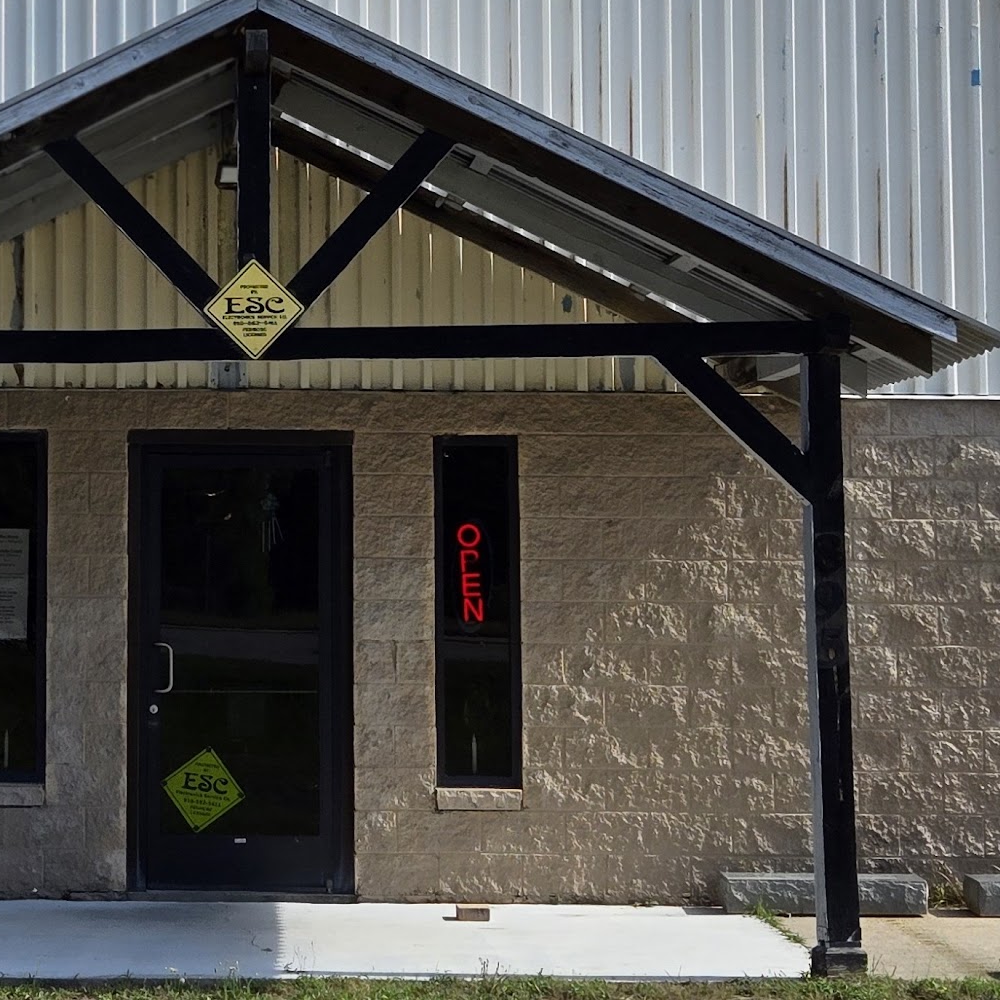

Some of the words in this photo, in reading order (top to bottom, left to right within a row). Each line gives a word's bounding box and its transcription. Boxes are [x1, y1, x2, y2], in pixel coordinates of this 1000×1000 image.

[224, 296, 285, 314] ESC
[457, 523, 483, 622] OPEN
[181, 772, 229, 795] ESC
